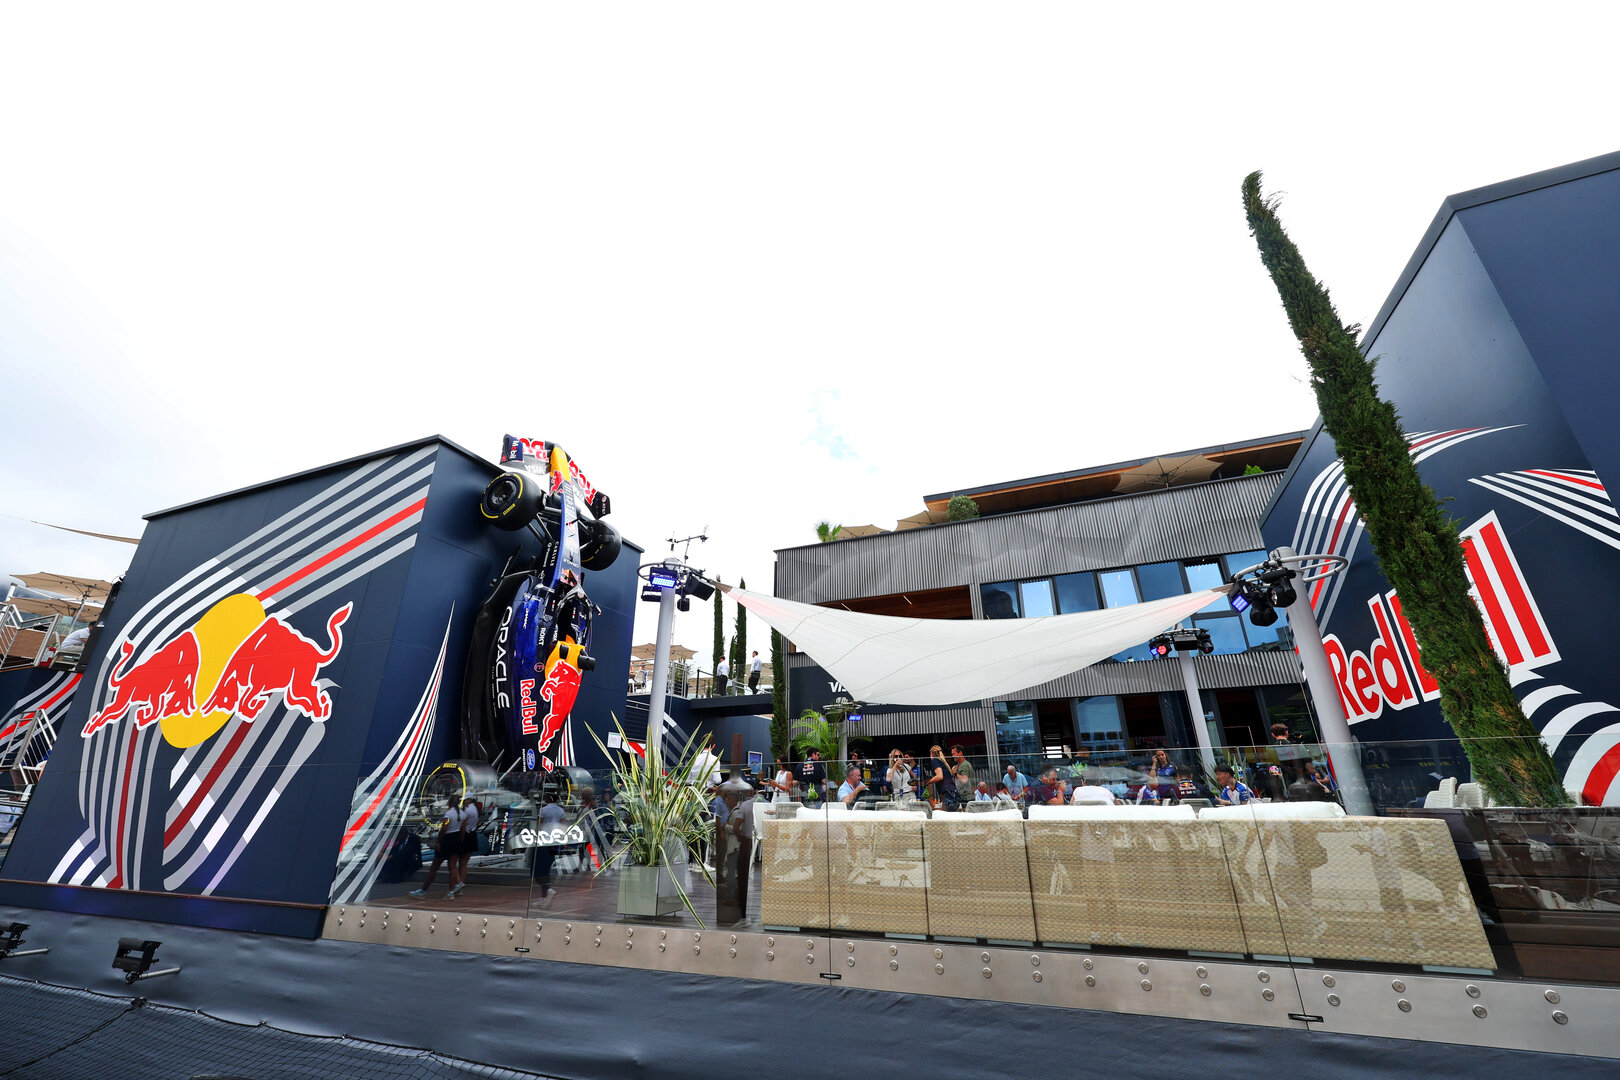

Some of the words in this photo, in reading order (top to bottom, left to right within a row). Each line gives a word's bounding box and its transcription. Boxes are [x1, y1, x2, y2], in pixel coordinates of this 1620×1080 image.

[538, 628, 546, 646] ROKT
[496, 606, 512, 709] ORACLE
[1322, 593, 1419, 725] Red
[520, 679, 535, 706] Red
[523, 707, 538, 735] Bull
